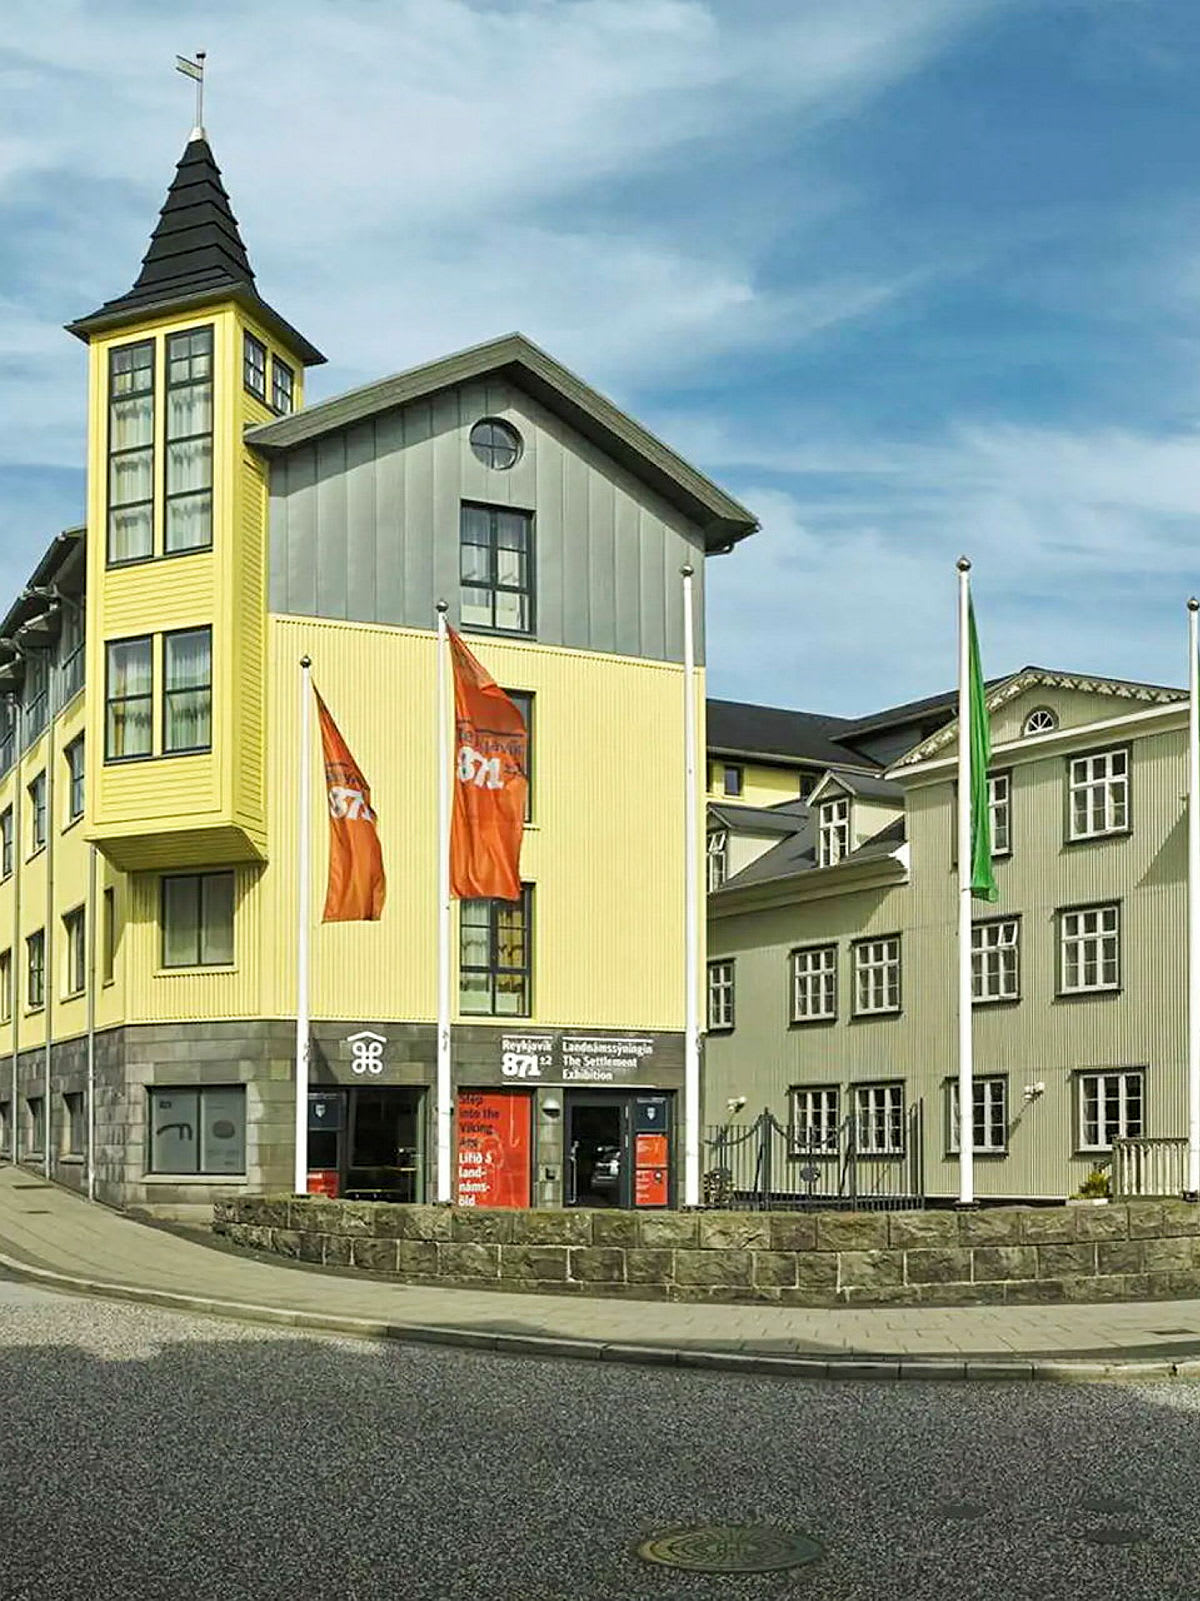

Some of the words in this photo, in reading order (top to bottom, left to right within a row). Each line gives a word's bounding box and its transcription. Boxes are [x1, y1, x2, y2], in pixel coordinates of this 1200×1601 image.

[458, 746, 504, 789] 871
[563, 1055, 581, 1067] The
[584, 1055, 637, 1068] Settlement
[562, 1068, 613, 1081] Exhibition
[483, 1108, 499, 1119] the
